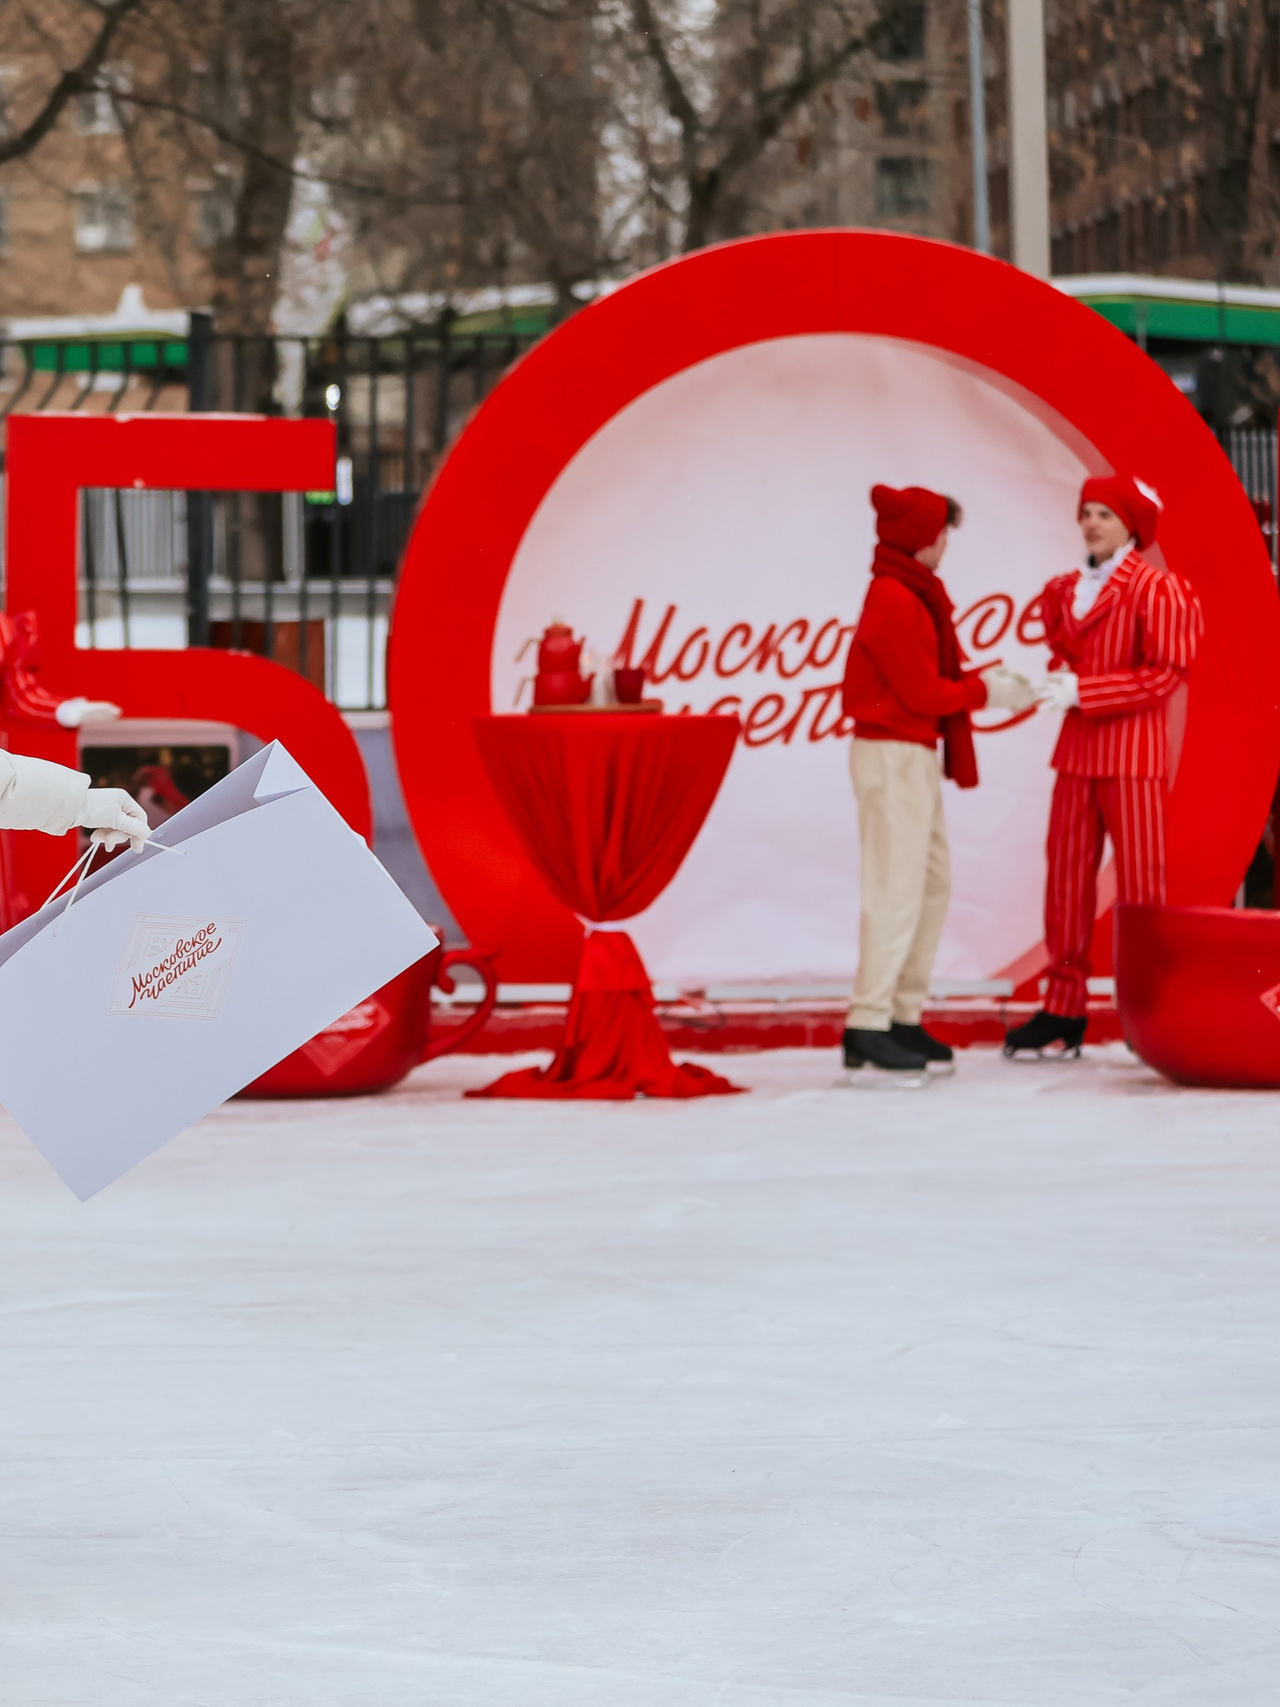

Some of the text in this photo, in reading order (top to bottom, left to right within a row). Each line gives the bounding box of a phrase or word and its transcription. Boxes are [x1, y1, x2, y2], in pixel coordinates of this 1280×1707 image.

[609, 592, 1048, 684] Москокое
[128, 922, 217, 1008] Московское
[139, 938, 222, 1000] чаепитие
